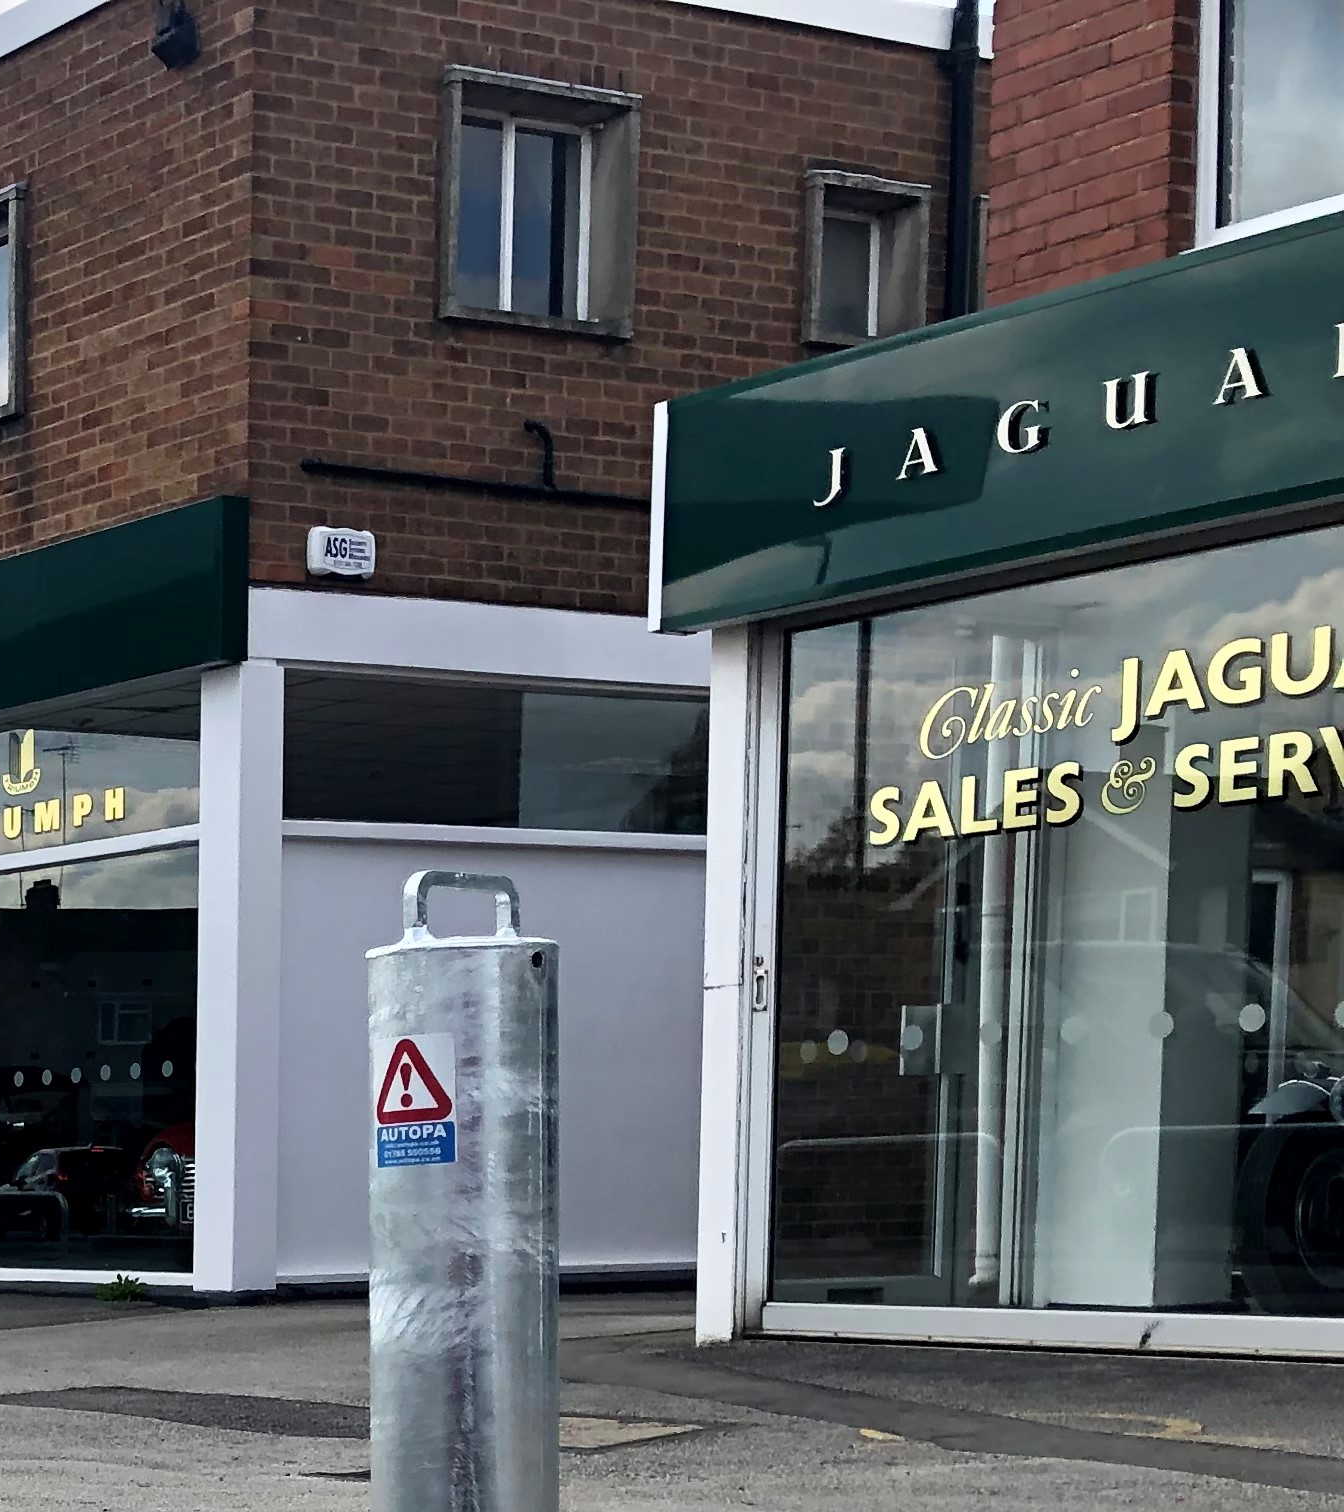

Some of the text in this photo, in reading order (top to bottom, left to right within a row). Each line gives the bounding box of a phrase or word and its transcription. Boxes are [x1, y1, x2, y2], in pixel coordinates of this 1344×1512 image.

[324, 536, 348, 559] ASG
[918, 625, 1344, 760] Classic JAGU
[869, 761, 1085, 847] SALES
[1101, 756, 1158, 815] &
[380, 1124, 447, 1142] AUTOPA
